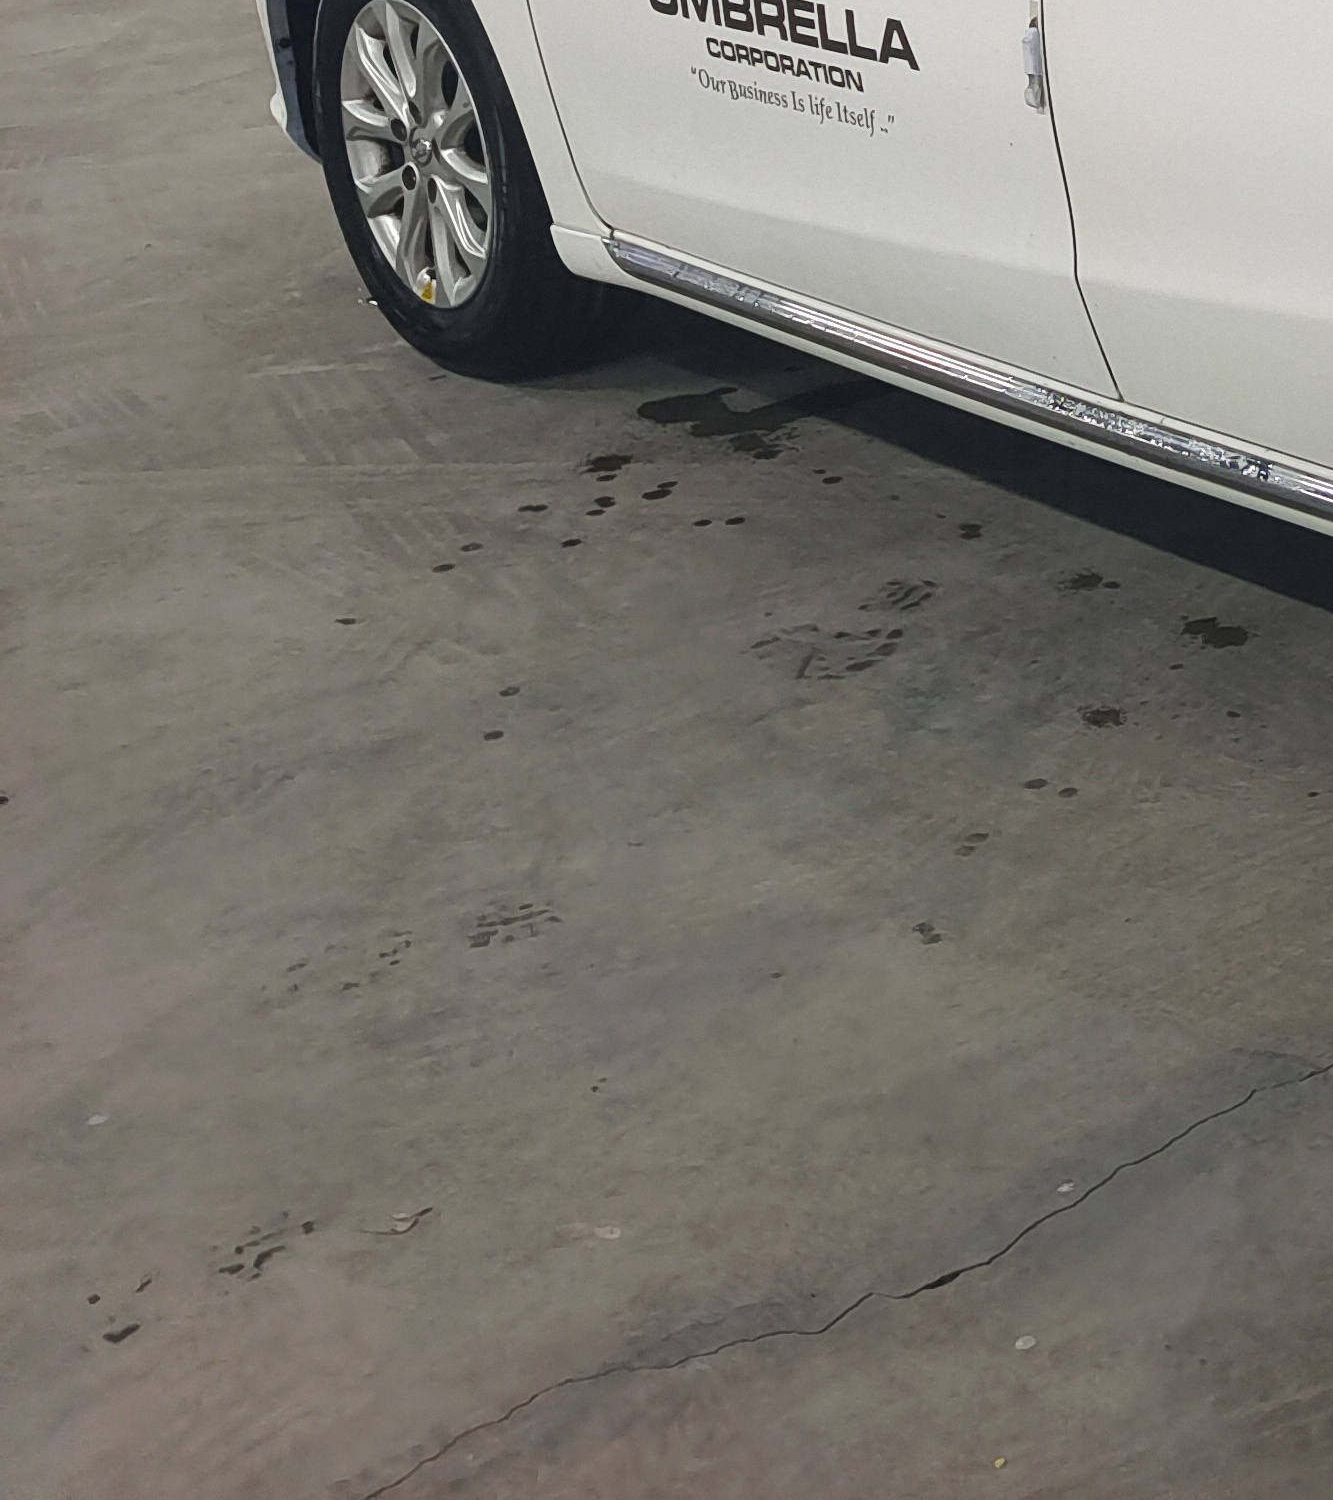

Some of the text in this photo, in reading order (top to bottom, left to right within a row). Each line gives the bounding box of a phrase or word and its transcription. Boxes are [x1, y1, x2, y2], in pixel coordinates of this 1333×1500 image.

[706, 36, 864, 93] CORPORATION
[728, 78, 788, 109] Business
[791, 90, 805, 113] Is
